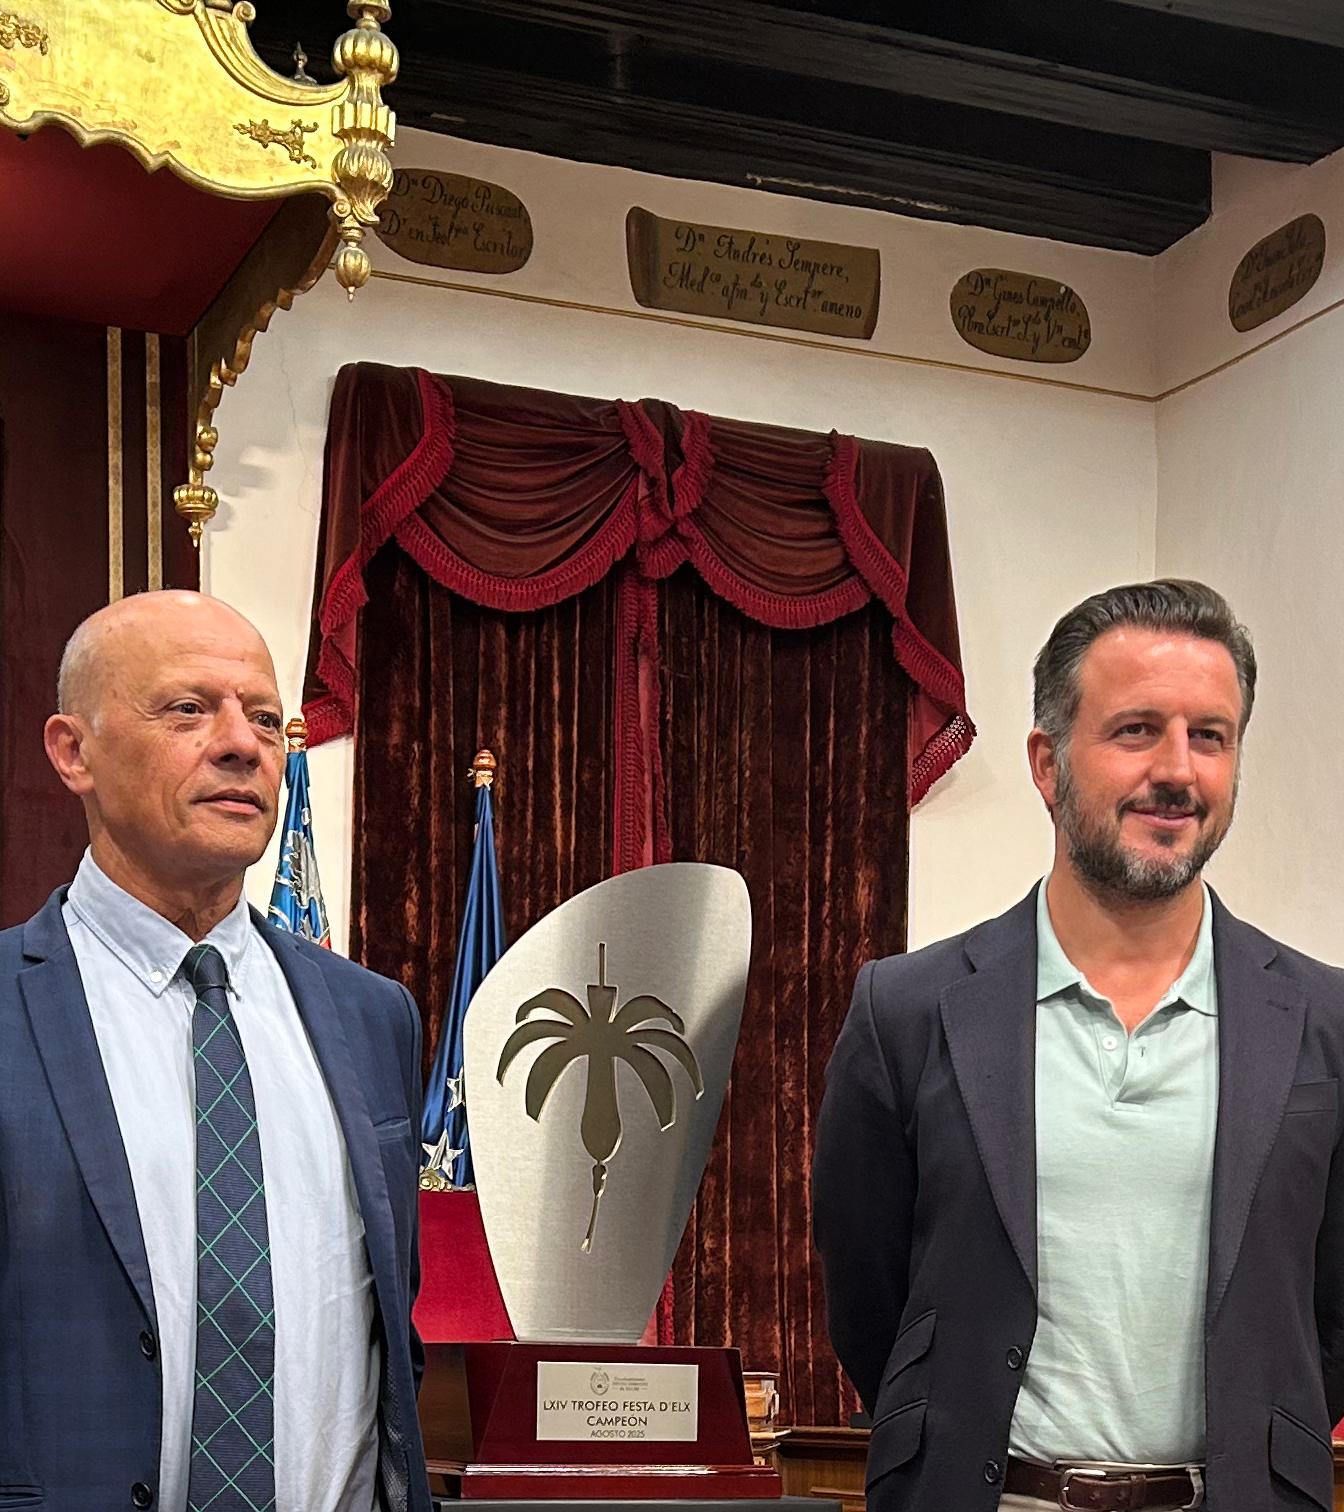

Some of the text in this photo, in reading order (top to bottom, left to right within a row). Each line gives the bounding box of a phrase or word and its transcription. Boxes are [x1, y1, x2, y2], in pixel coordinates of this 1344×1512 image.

[713, 233, 774, 267] Andrés
[543, 1400, 568, 1411] LXIV
[571, 1400, 619, 1412] TROFEO
[622, 1401, 656, 1412] FESTA
[586, 1414, 648, 1427] CAMPEÓN
[590, 1430, 626, 1438] AGOSTO
